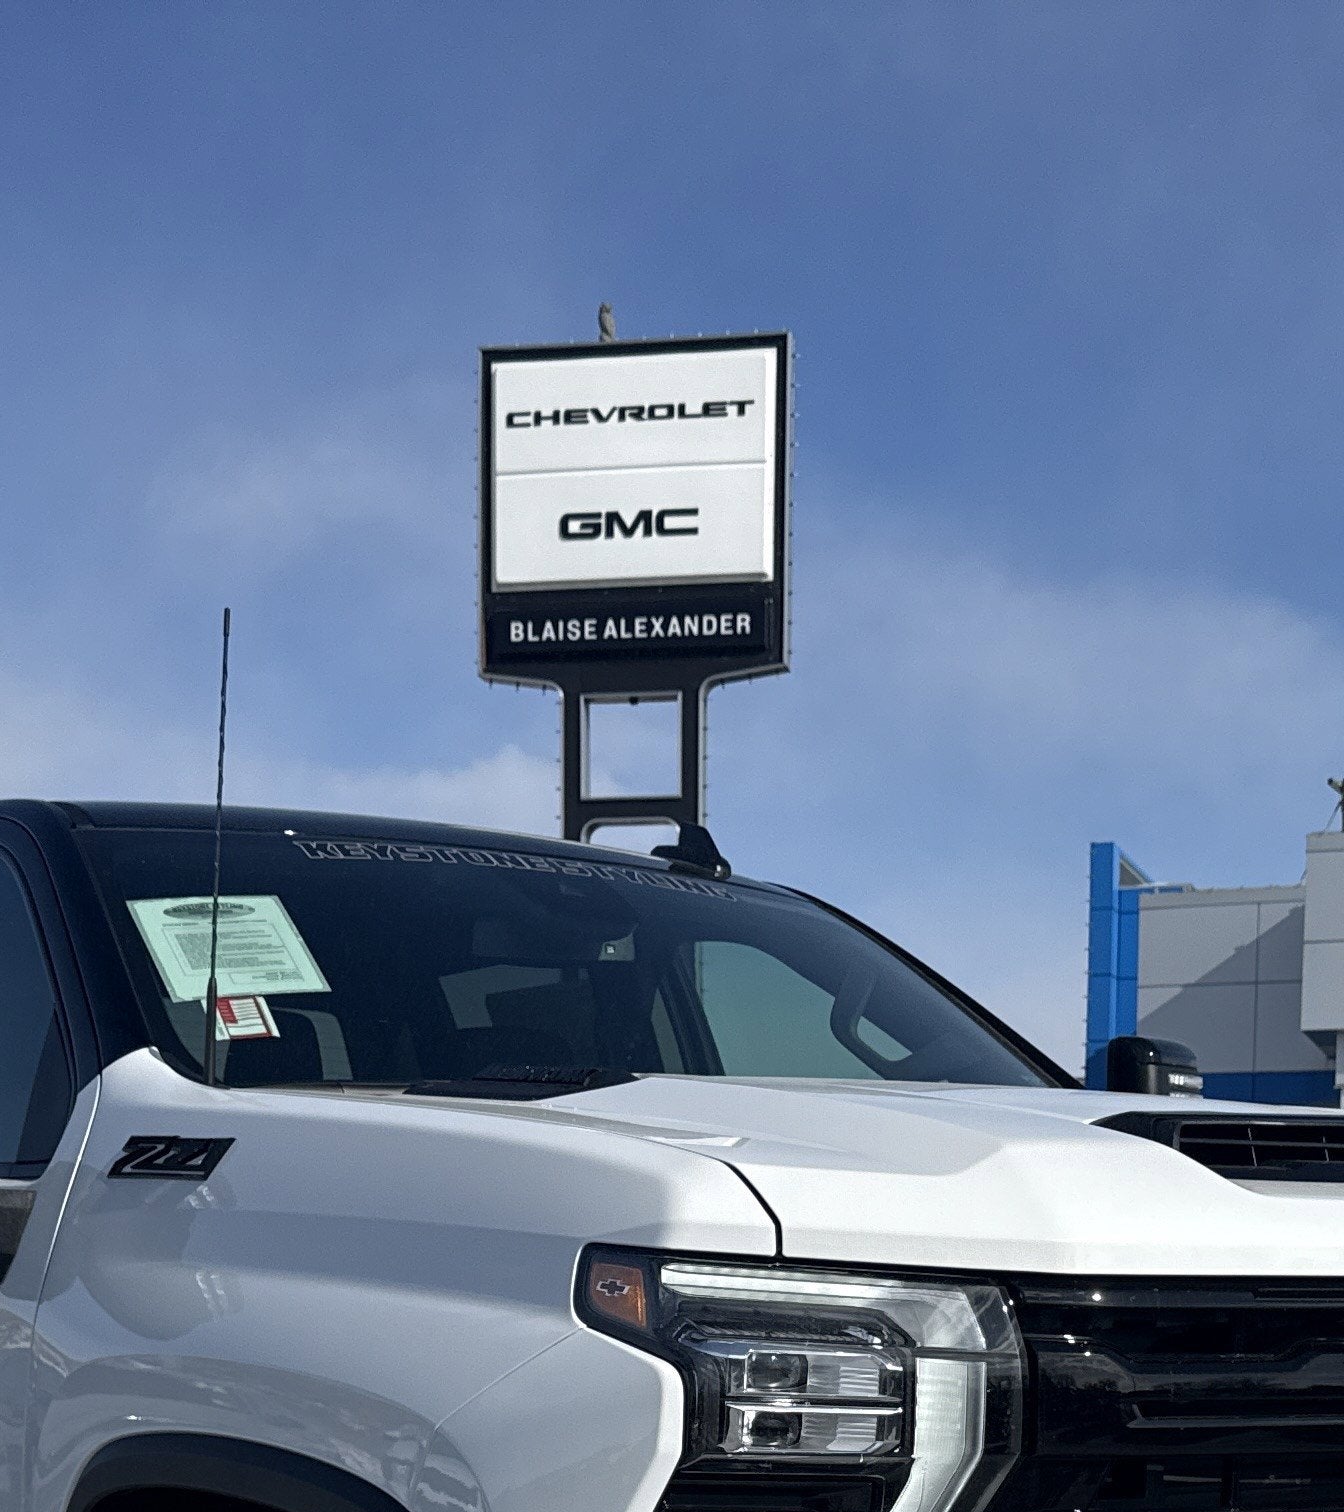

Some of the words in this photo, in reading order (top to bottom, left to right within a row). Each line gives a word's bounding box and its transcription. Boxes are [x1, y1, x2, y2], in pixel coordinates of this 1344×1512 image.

[506, 399, 754, 428] CHEVROLET
[559, 507, 699, 541] GMC
[509, 618, 598, 643] BLAISE
[603, 613, 752, 639] ALEXANDER
